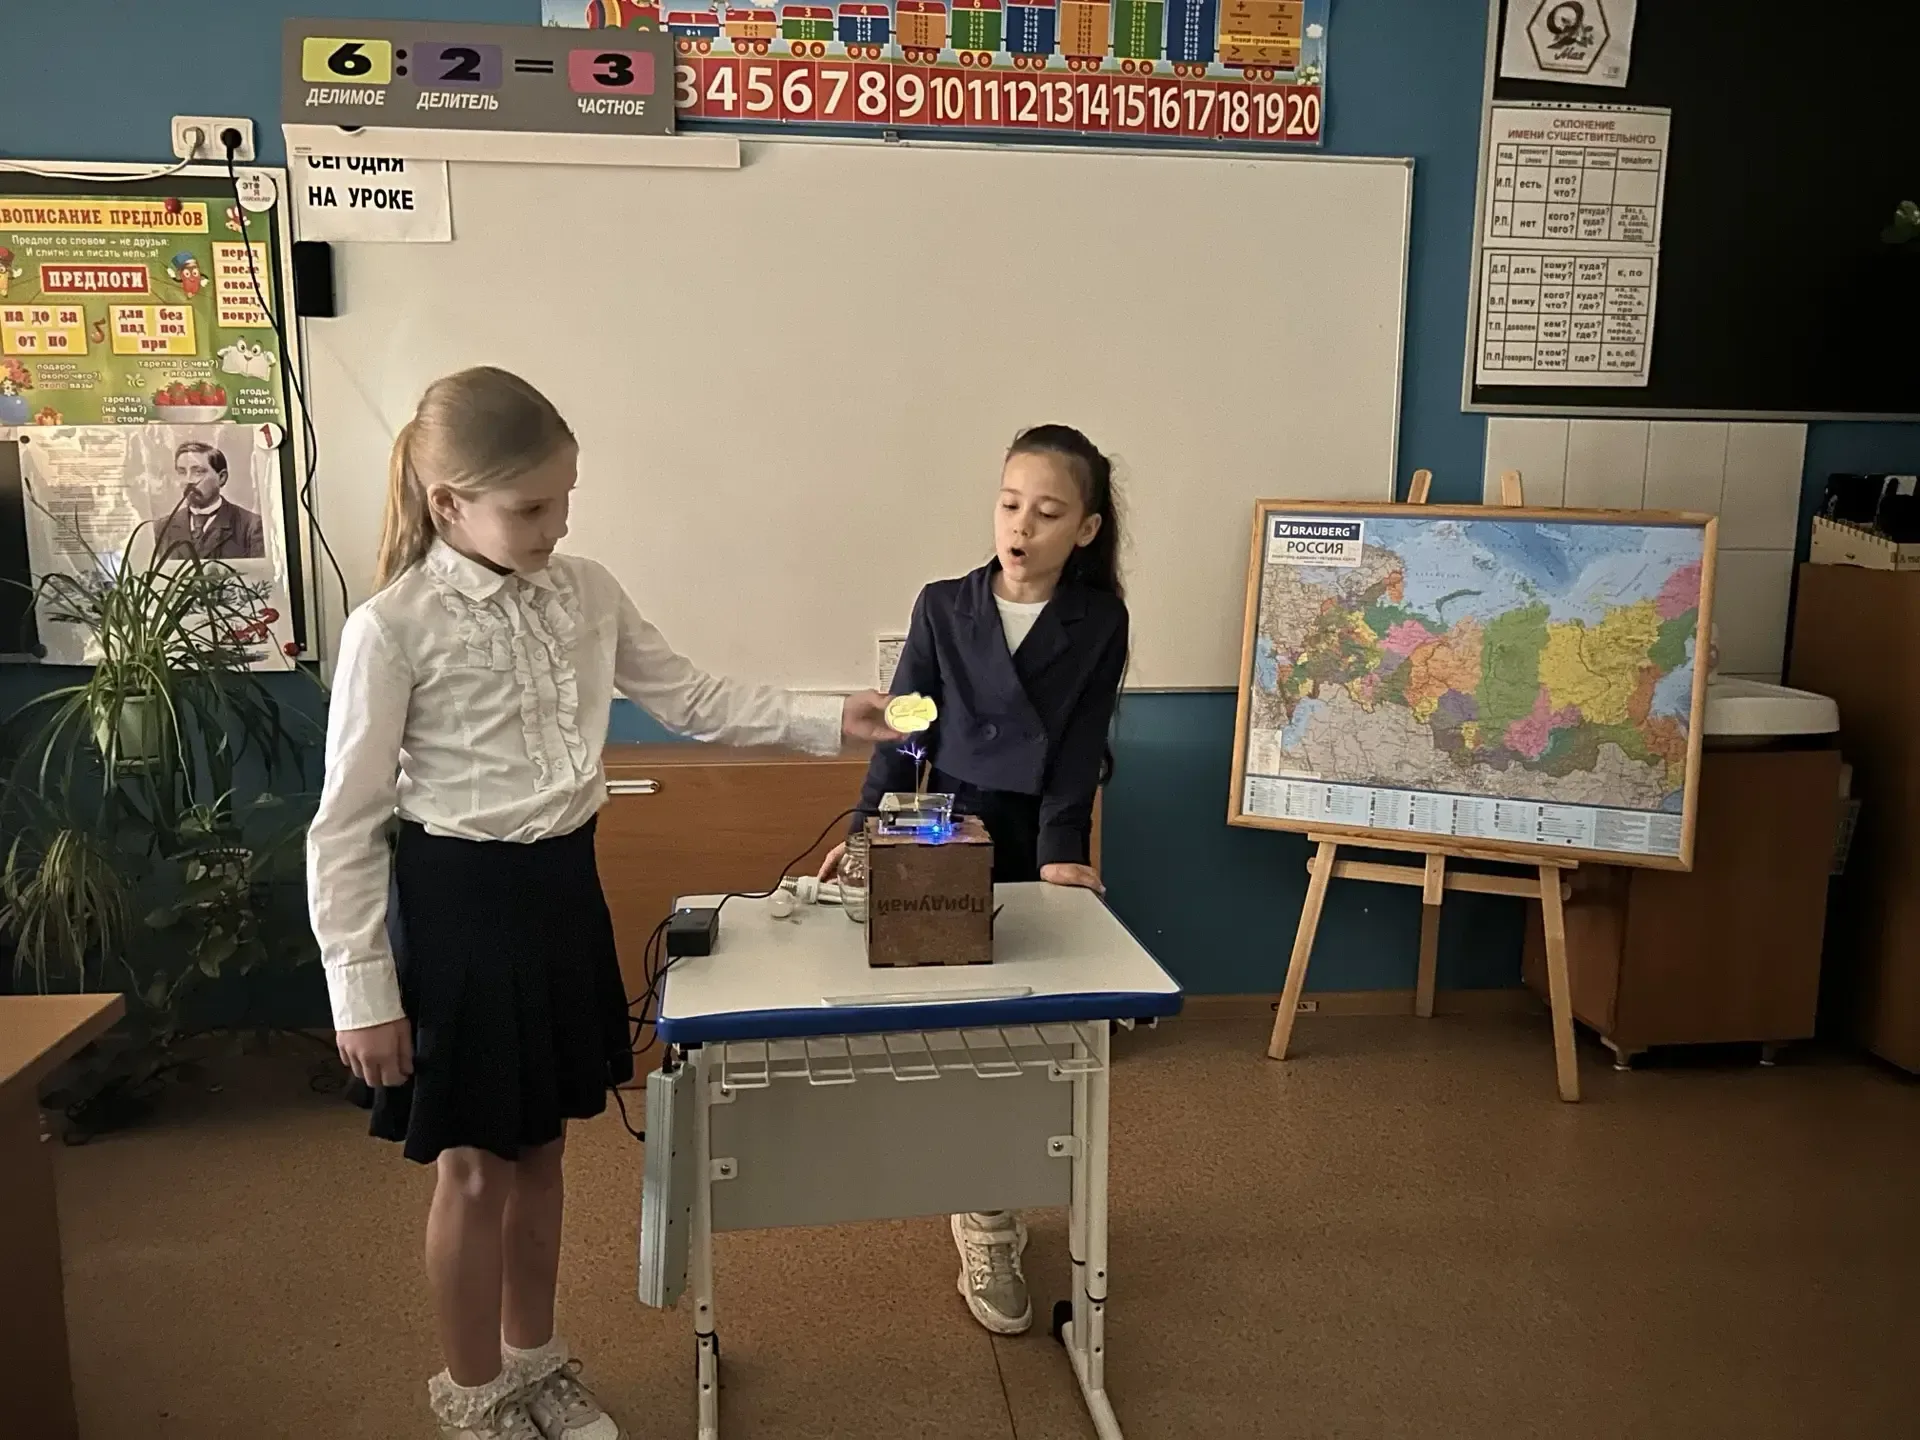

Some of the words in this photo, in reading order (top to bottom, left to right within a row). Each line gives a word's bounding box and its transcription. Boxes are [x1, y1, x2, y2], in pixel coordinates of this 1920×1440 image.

[860, 6, 867, 15] 4
[918, 3, 924, 12] 5
[748, 11, 754, 20] 2
[804, 8, 811, 17] 3
[1554, 47, 1585, 60] Мая
[327, 43, 372, 76] 6
[439, 47, 481, 82] 2
[593, 53, 634, 87] 3
[306, 88, 385, 106] ДЕЛИМОЕ
[417, 92, 499, 111] ДЕЛИТЕЛЬ
[675, 65, 697, 108] 3
[706, 67, 738, 111] 4
[746, 67, 772, 112] 5
[782, 68, 809, 113] 6
[820, 70, 849, 114] 7
[857, 71, 887, 116] 8
[896, 74, 924, 118] 9
[930, 77, 964, 120] 10
[968, 79, 999, 121] 11
[1003, 81, 1038, 122] 12
[1040, 82, 1074, 124] 13
[1076, 83, 1109, 125] 14
[1113, 85, 1145, 127] 15
[1148, 87, 1181, 129] 16
[1183, 89, 1215, 131] 17
[1218, 90, 1249, 133] 18
[1254, 92, 1285, 134] 19
[1286, 94, 1320, 136] 20
[577, 98, 645, 116] ЧАСТНОЕ
[1553, 119, 1615, 130] СКЛОНЕНИЕ
[1508, 130, 1544, 139] ИМЕНИ
[1547, 131, 1656, 144] СУЩЕСТВИТЕЛЬНОГО
[308, 155, 404, 175] СЕГОДНЯ
[1555, 175, 1577, 184] кто?
[1554, 188, 1576, 197] что?
[308, 186, 337, 208] НА
[349, 189, 414, 210] УРОКЕ
[0, 208, 102, 224] ВОПИСАНИЕ
[109, 210, 203, 228] ПРЕДЛОГОВ
[1548, 212, 1575, 220] кого?
[1583, 218, 1605, 227] куда?
[1547, 225, 1574, 233] чего?
[12, 234, 53, 246] Предлог
[56, 237, 67, 245] со
[70, 237, 105, 245] словом
[120, 238, 131, 246] не
[133, 238, 170, 248] друзья:
[26, 247, 33, 256] И
[36, 249, 70, 257] слитно
[73, 249, 83, 257] их
[87, 249, 120, 258] писать
[123, 248, 159, 258] нелья!
[1544, 262, 1573, 271] кому?
[1579, 263, 1606, 271] куда?
[48, 271, 144, 290] ПРЕДЛОГИ
[1544, 272, 1572, 280] чему?
[1581, 272, 1602, 280] где?
[1544, 292, 1570, 300] кого?
[1577, 292, 1603, 300] куда?
[1512, 298, 1535, 307] вижу
[1545, 301, 1567, 309] что?
[1579, 302, 1600, 311] где?
[4, 311, 24, 322] на
[31, 311, 50, 325] до
[60, 311, 78, 323] за
[118, 309, 143, 320] для
[159, 309, 183, 320] без
[222, 312, 266, 323] вокруг
[1544, 320, 1566, 328] кем?
[1574, 321, 1601, 330] куда?
[120, 323, 146, 334] над
[160, 323, 186, 335] под
[1543, 330, 1566, 338] чем?
[1576, 331, 1597, 339] где?
[18, 336, 36, 347] от
[48, 336, 67, 347] по
[141, 339, 167, 351] при
[1575, 354, 1595, 362] где?
[1544, 359, 1566, 367] чем?
[242, 408, 280, 416] тарелке
[260, 424, 273, 448] 1
[1292, 526, 1350, 537] BRAUBERG
[1287, 541, 1344, 554] РОССИЯ
[877, 894, 985, 916] Придумай
